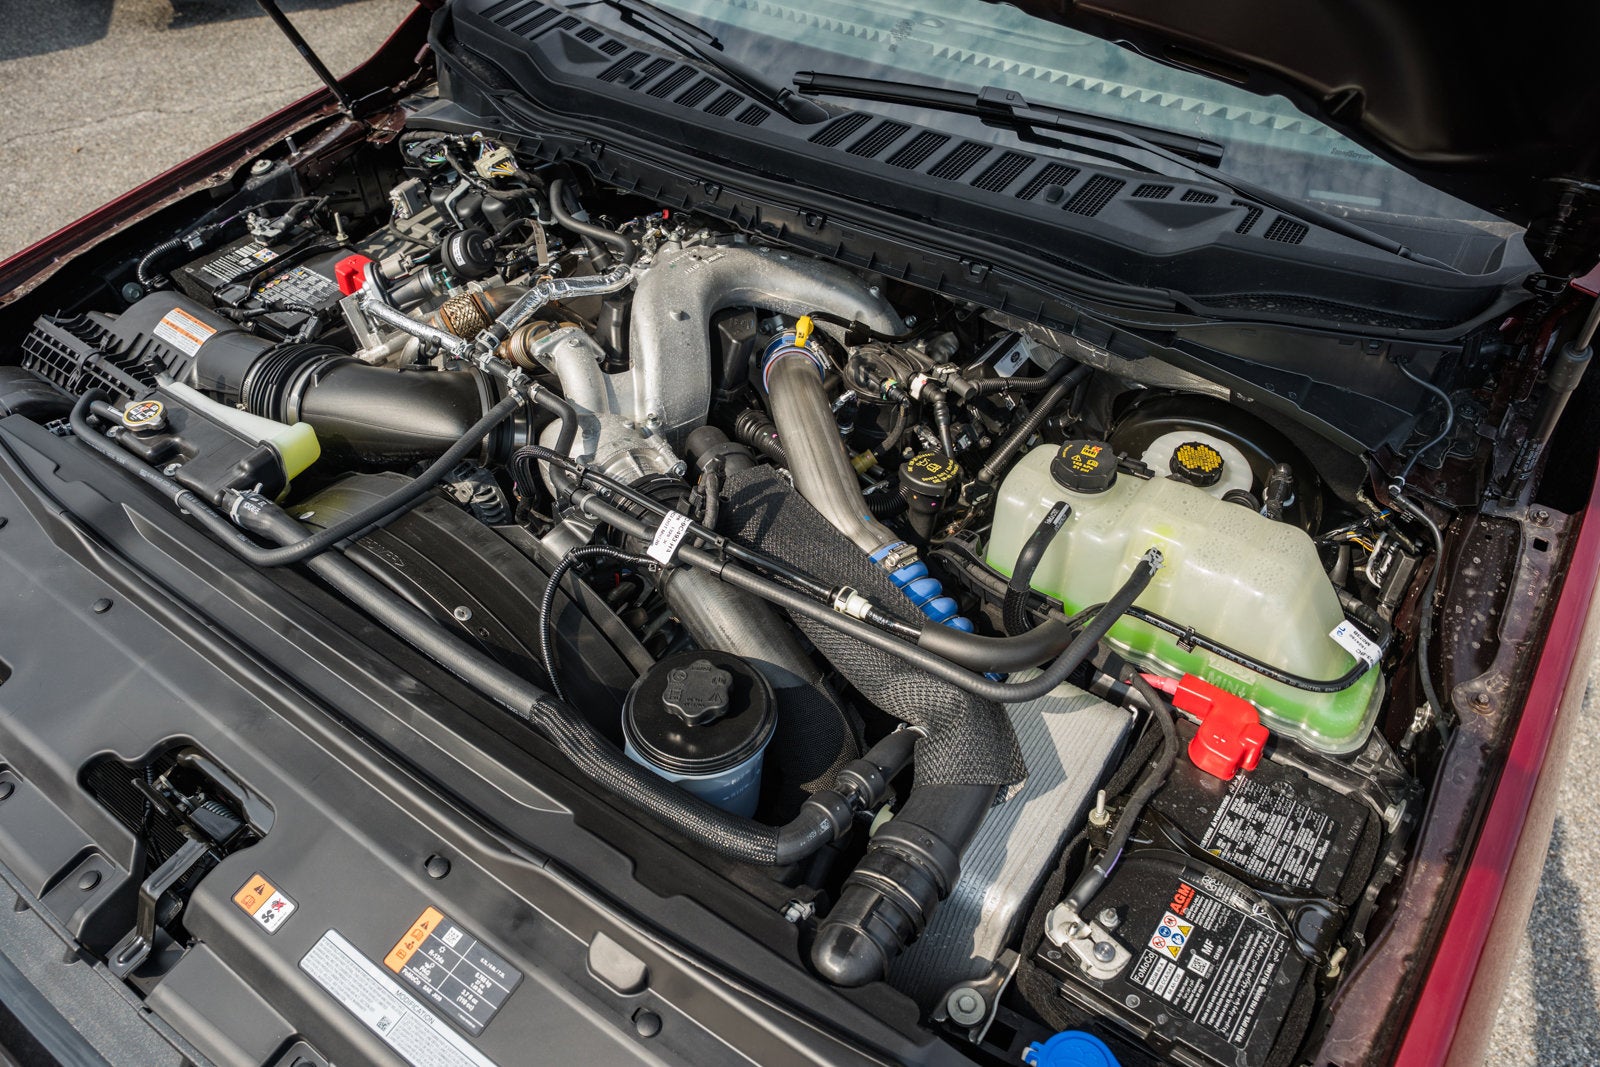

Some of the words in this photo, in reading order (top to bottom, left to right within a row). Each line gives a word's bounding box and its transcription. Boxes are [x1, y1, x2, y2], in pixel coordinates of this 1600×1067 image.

[1171, 884, 1190, 912] AGM
[428, 949, 444, 964] R-134a
[1201, 939, 1214, 955] MF
[420, 966, 430, 975] PAG
[1134, 952, 1157, 983] FoMoCo
[402, 968, 420, 985] FoMoCo
[423, 985, 432, 994] SAE
[393, 990, 434, 1024] MODIFICATION
